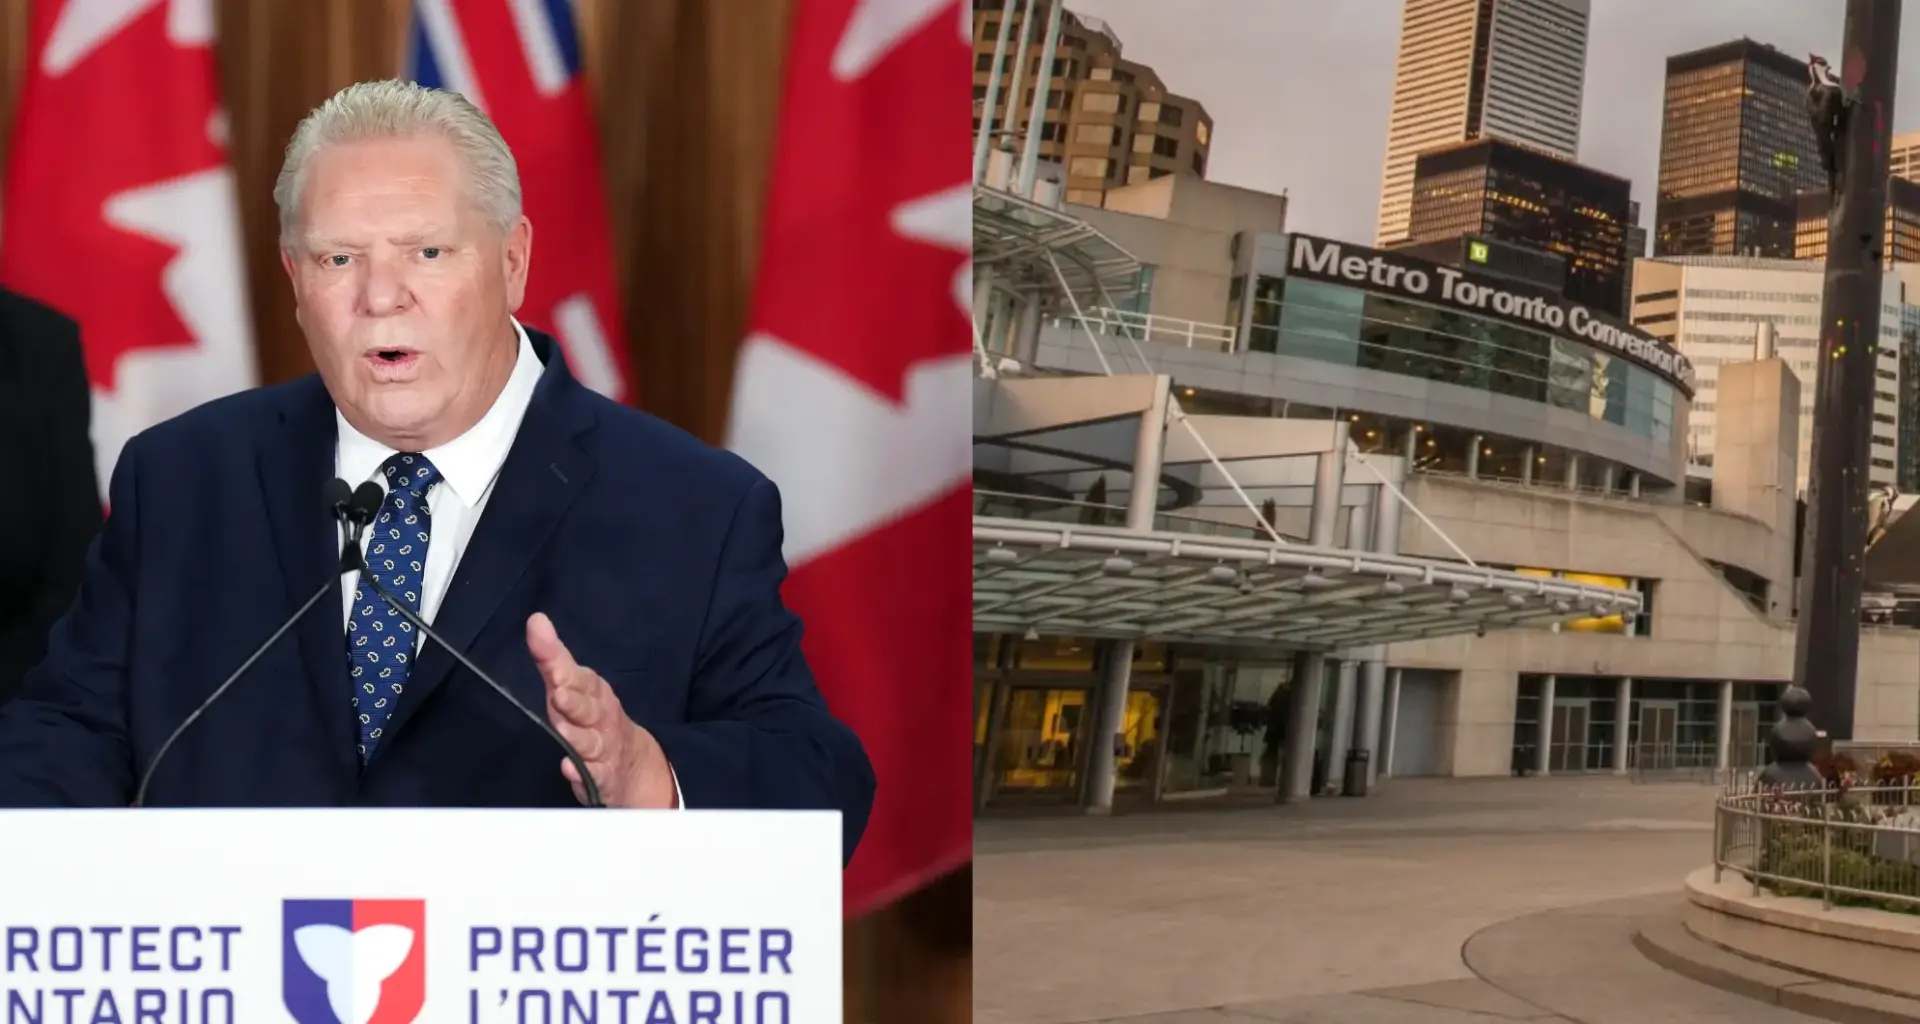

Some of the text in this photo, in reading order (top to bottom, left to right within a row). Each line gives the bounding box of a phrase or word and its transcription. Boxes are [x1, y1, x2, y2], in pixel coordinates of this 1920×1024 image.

[1292, 236, 1429, 294] Metro
[1436, 266, 1564, 328] Toronto
[1569, 306, 1672, 374] Convention
[6, 926, 242, 972] ROTECT
[469, 913, 793, 974] PROTÉGER
